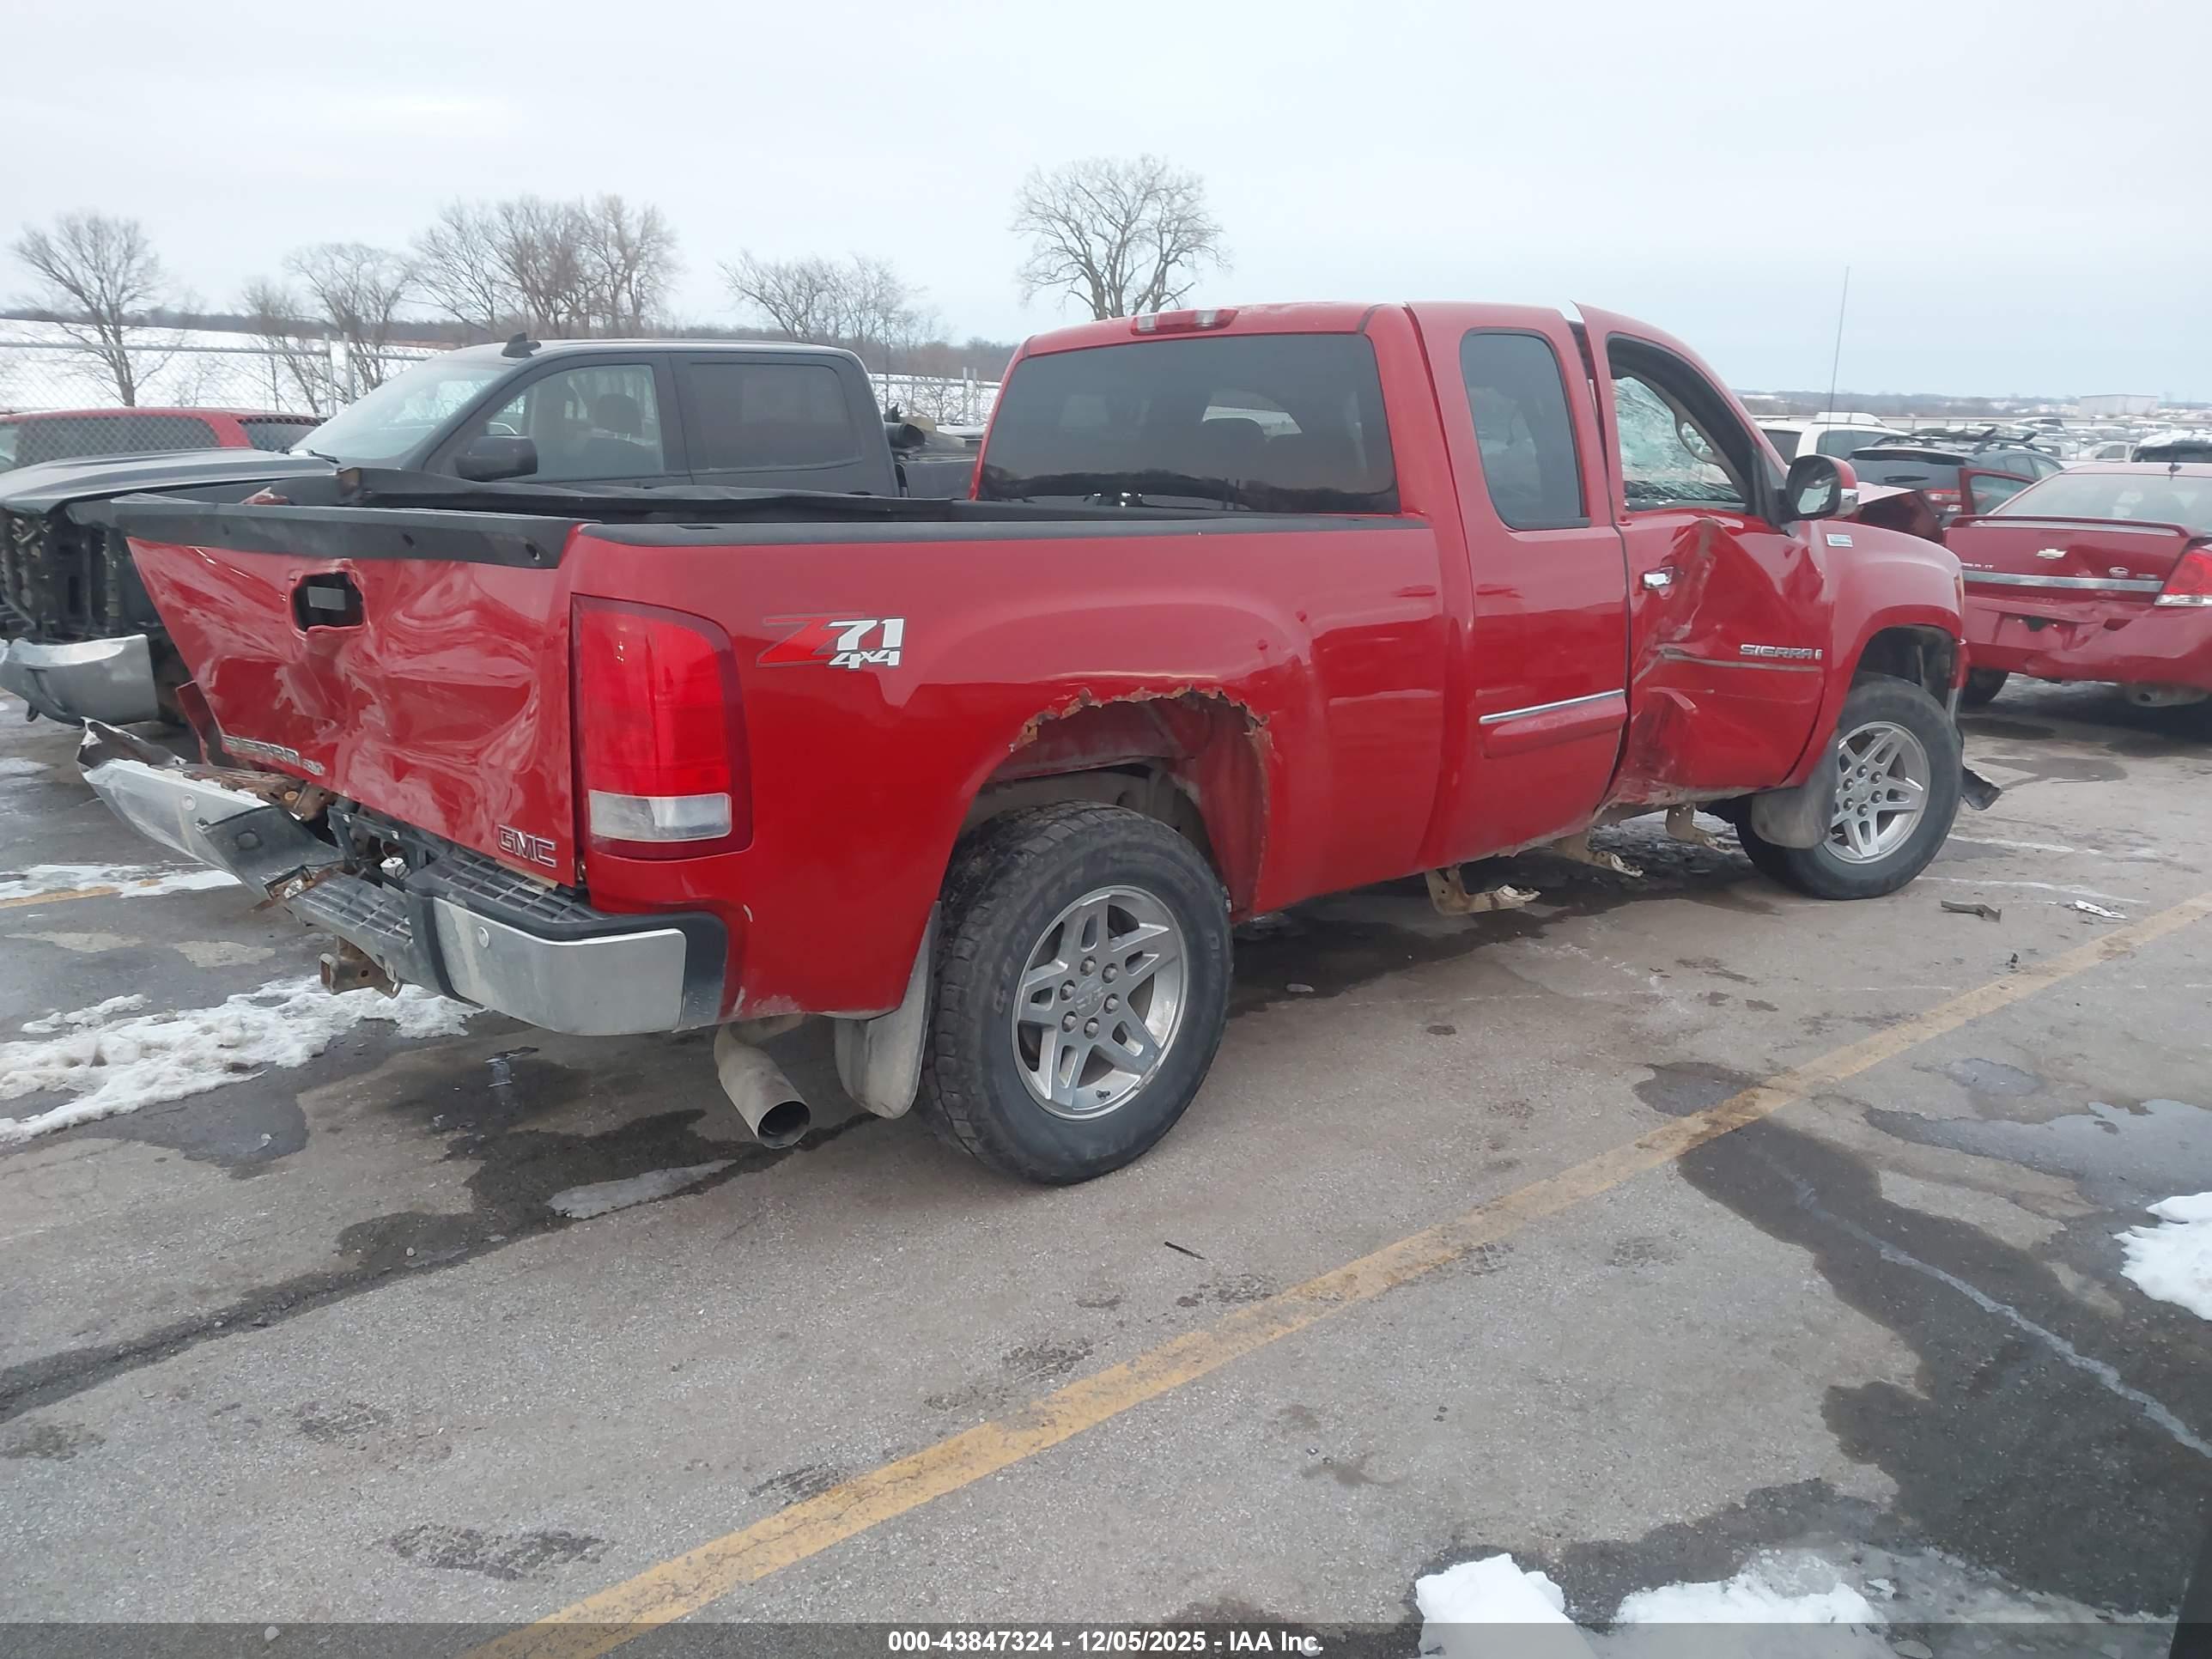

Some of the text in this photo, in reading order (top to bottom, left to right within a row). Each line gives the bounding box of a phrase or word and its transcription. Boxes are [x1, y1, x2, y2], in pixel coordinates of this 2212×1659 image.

[756, 611, 906, 668] Z71
[1740, 643, 1814, 660] SIERRA
[497, 823, 556, 868] GMC
